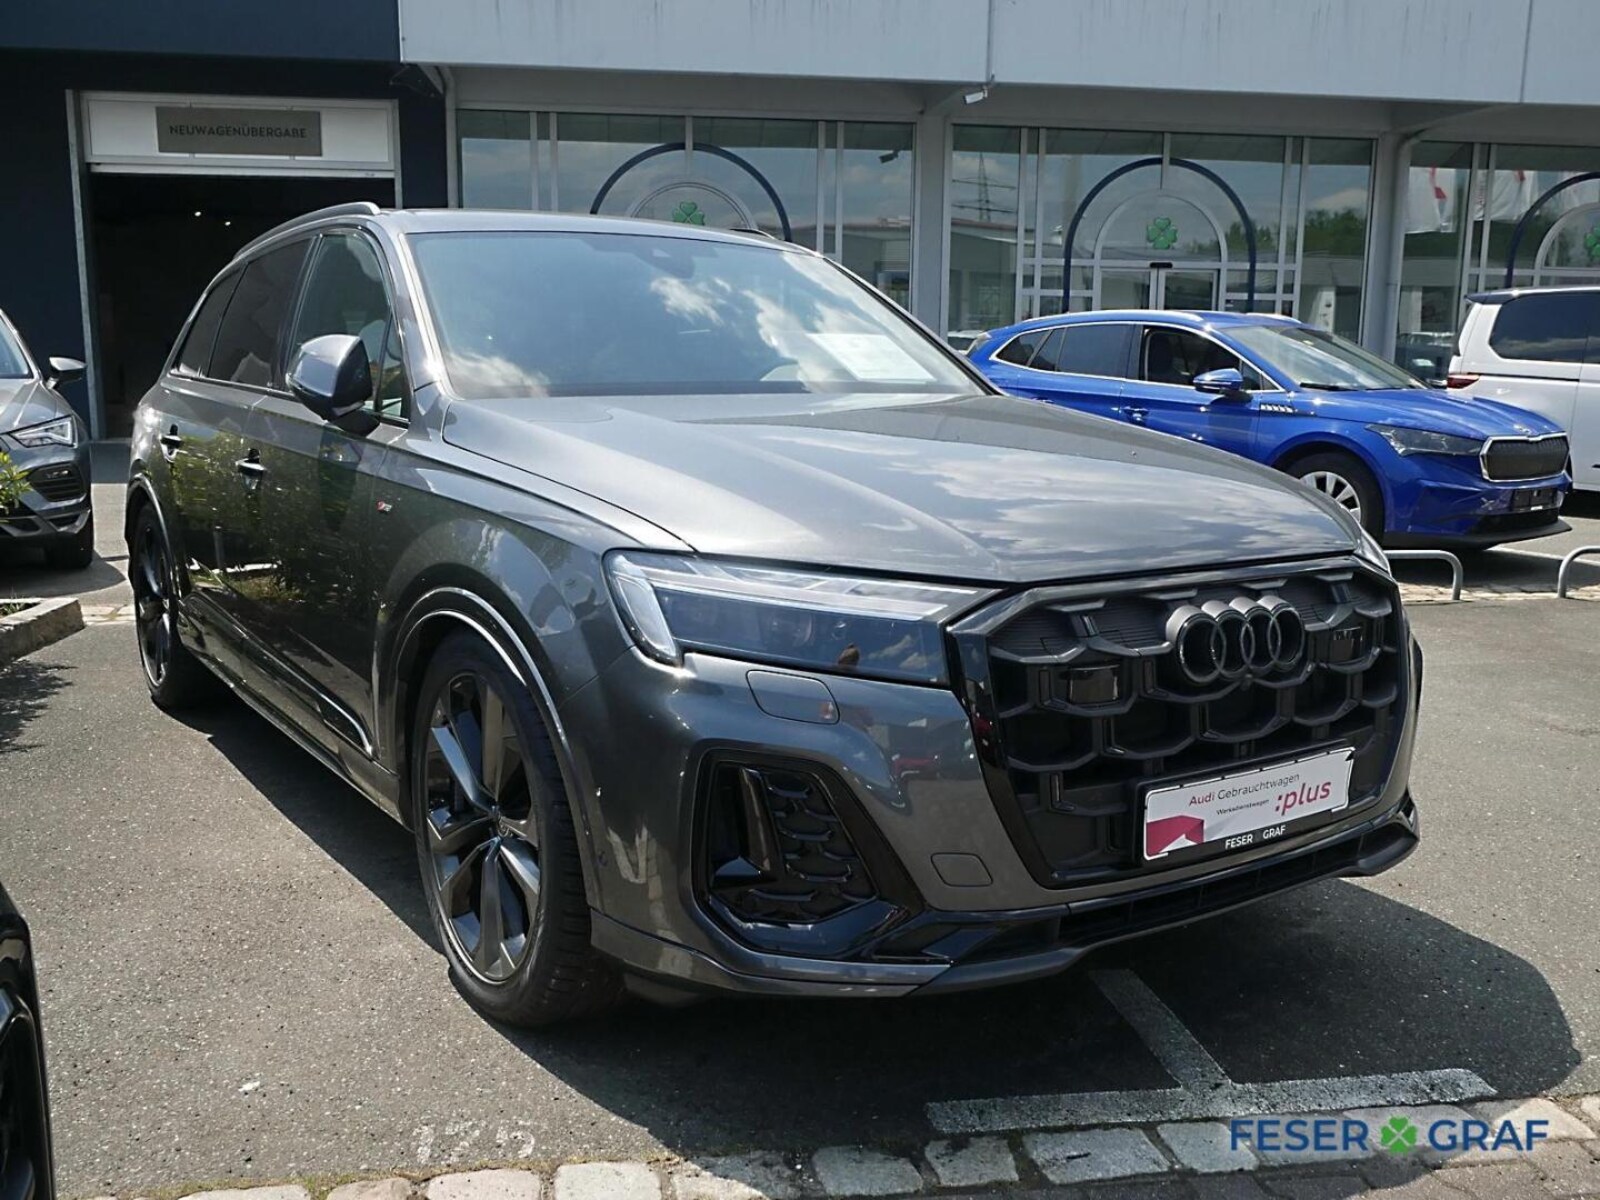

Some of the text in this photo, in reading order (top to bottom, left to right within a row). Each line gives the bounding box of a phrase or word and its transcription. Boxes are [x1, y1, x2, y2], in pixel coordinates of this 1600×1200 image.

[169, 124, 307, 138] NEUWAGENÜBERGABE
[1189, 773, 1300, 807] Audi Gebrauchtwagen
[1225, 825, 1287, 849] FESER GRAF
